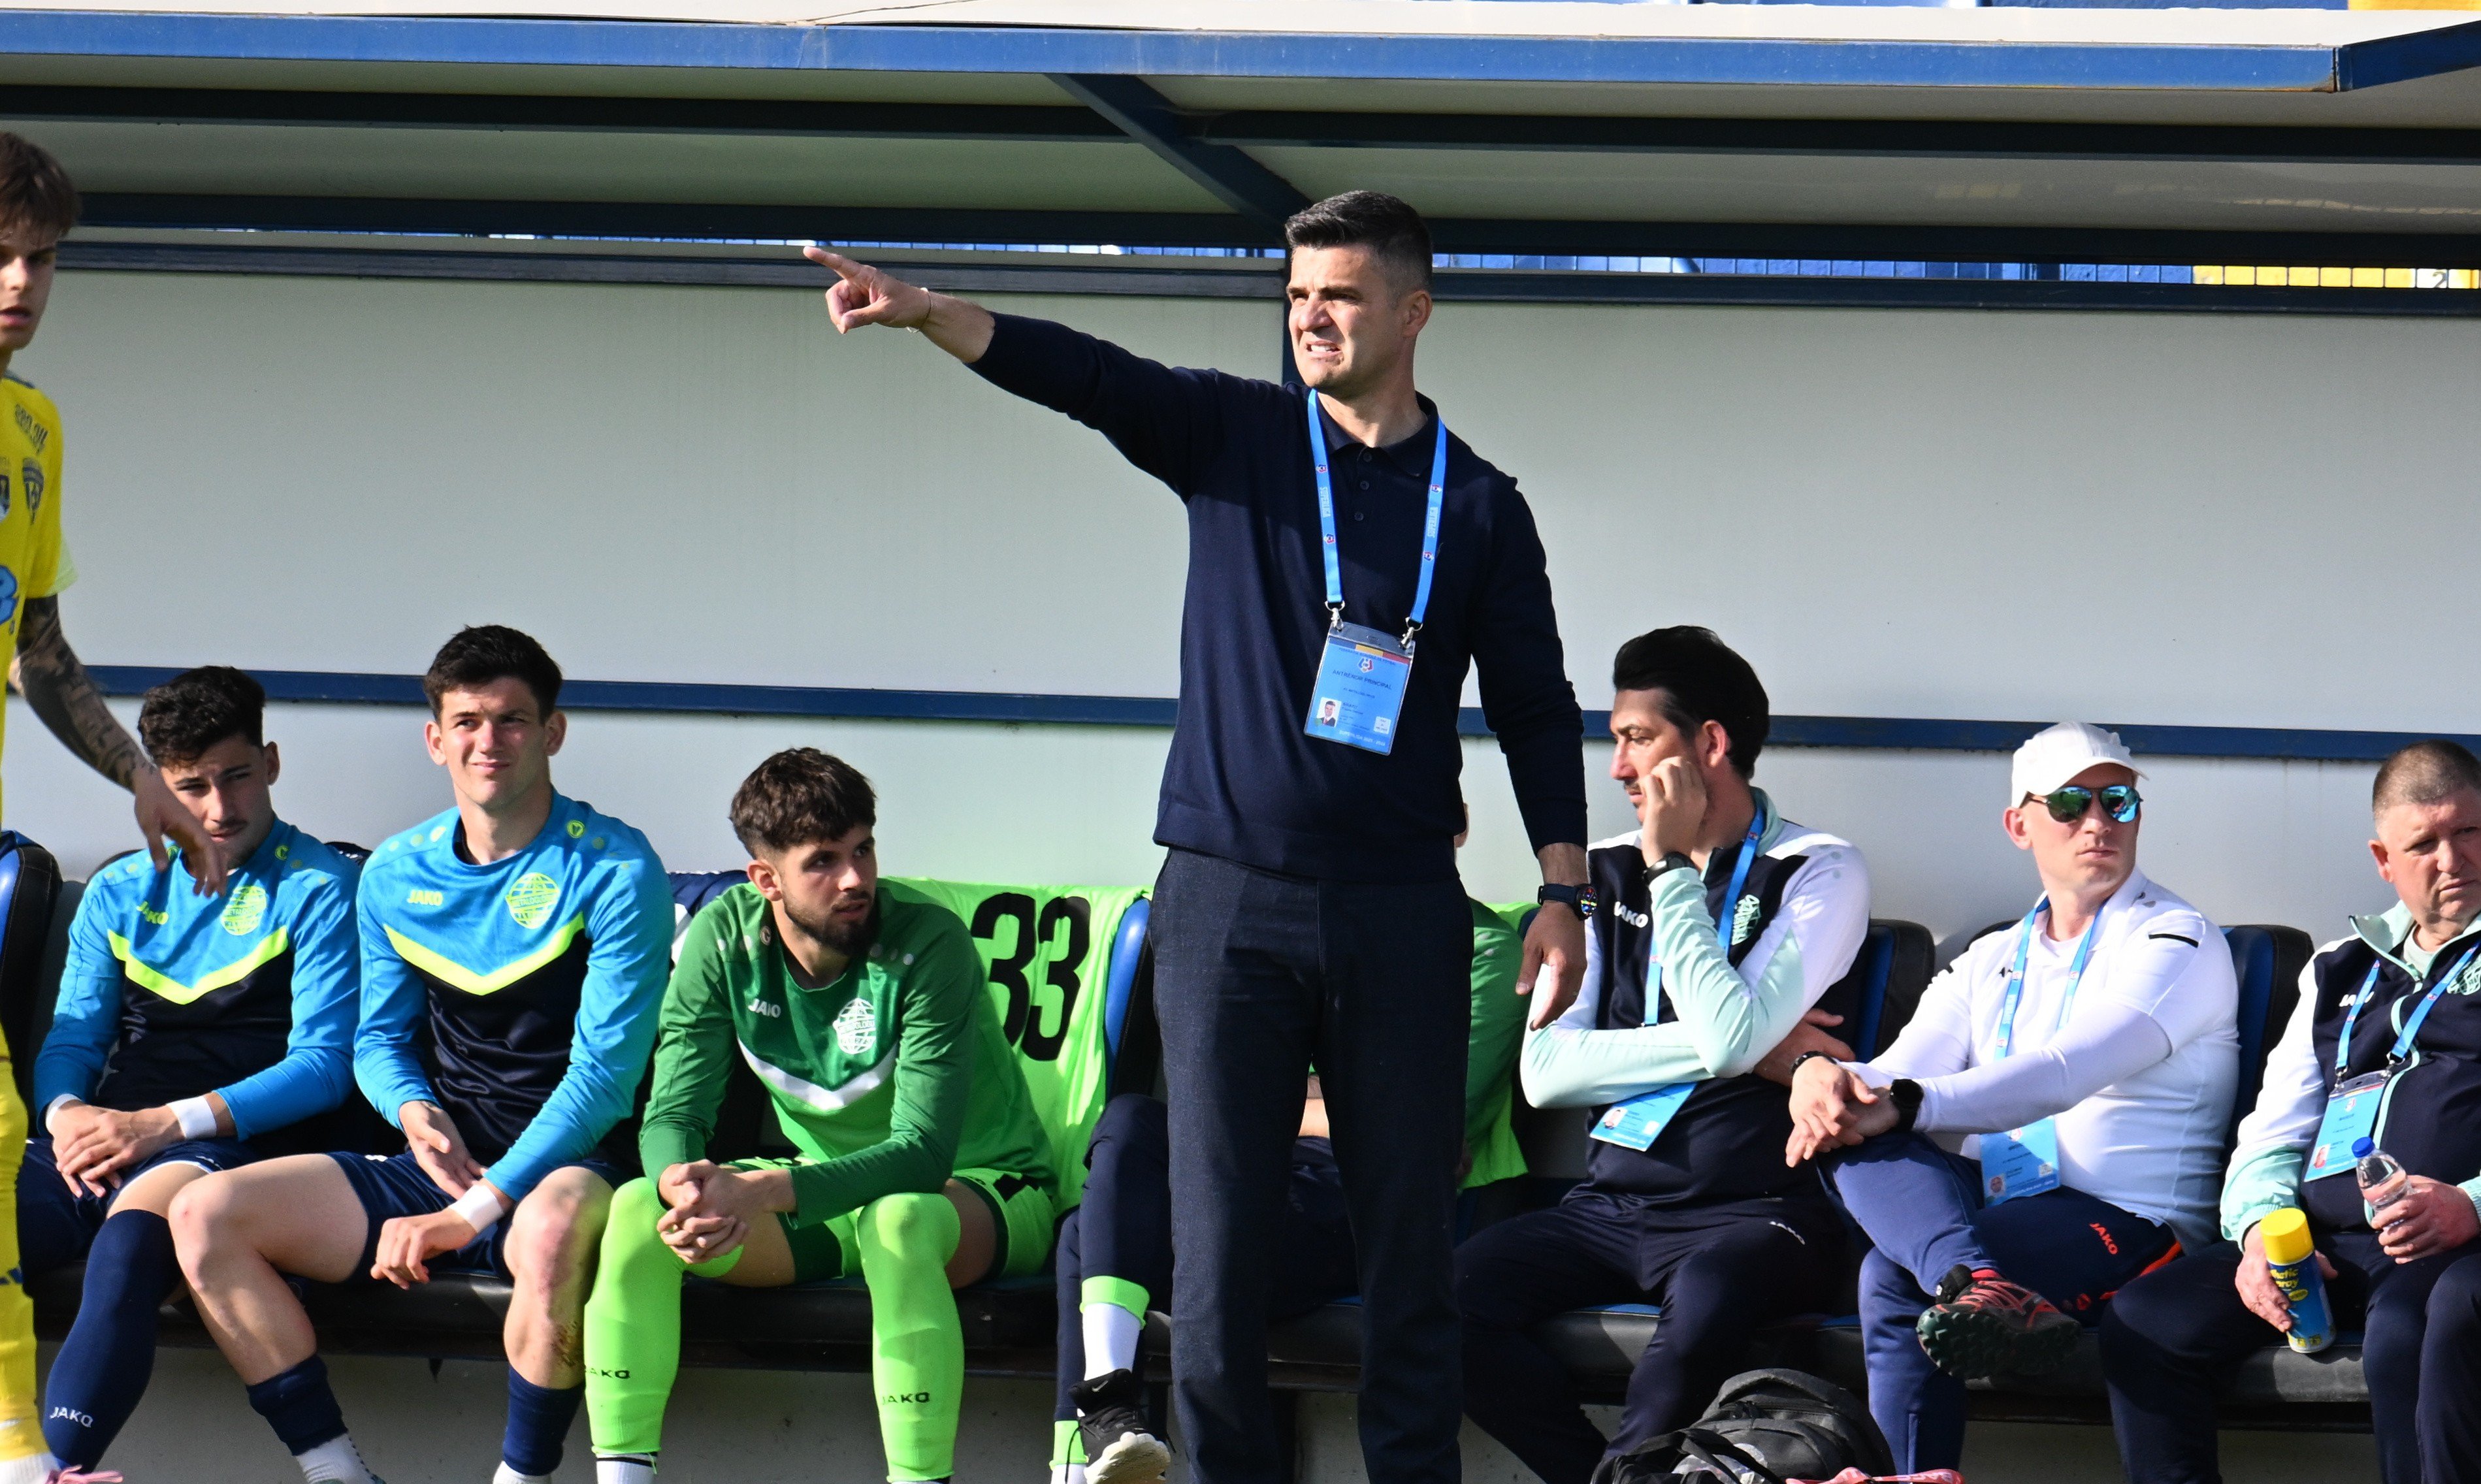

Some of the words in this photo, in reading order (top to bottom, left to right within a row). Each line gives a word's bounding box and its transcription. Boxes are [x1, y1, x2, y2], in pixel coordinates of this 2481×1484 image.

[407, 889, 443, 906] JAKO
[971, 892, 1091, 1061] 33
[2089, 1223, 2118, 1255] JAKO
[585, 1366, 631, 1379] AKO
[50, 1406, 93, 1428] JAKO
